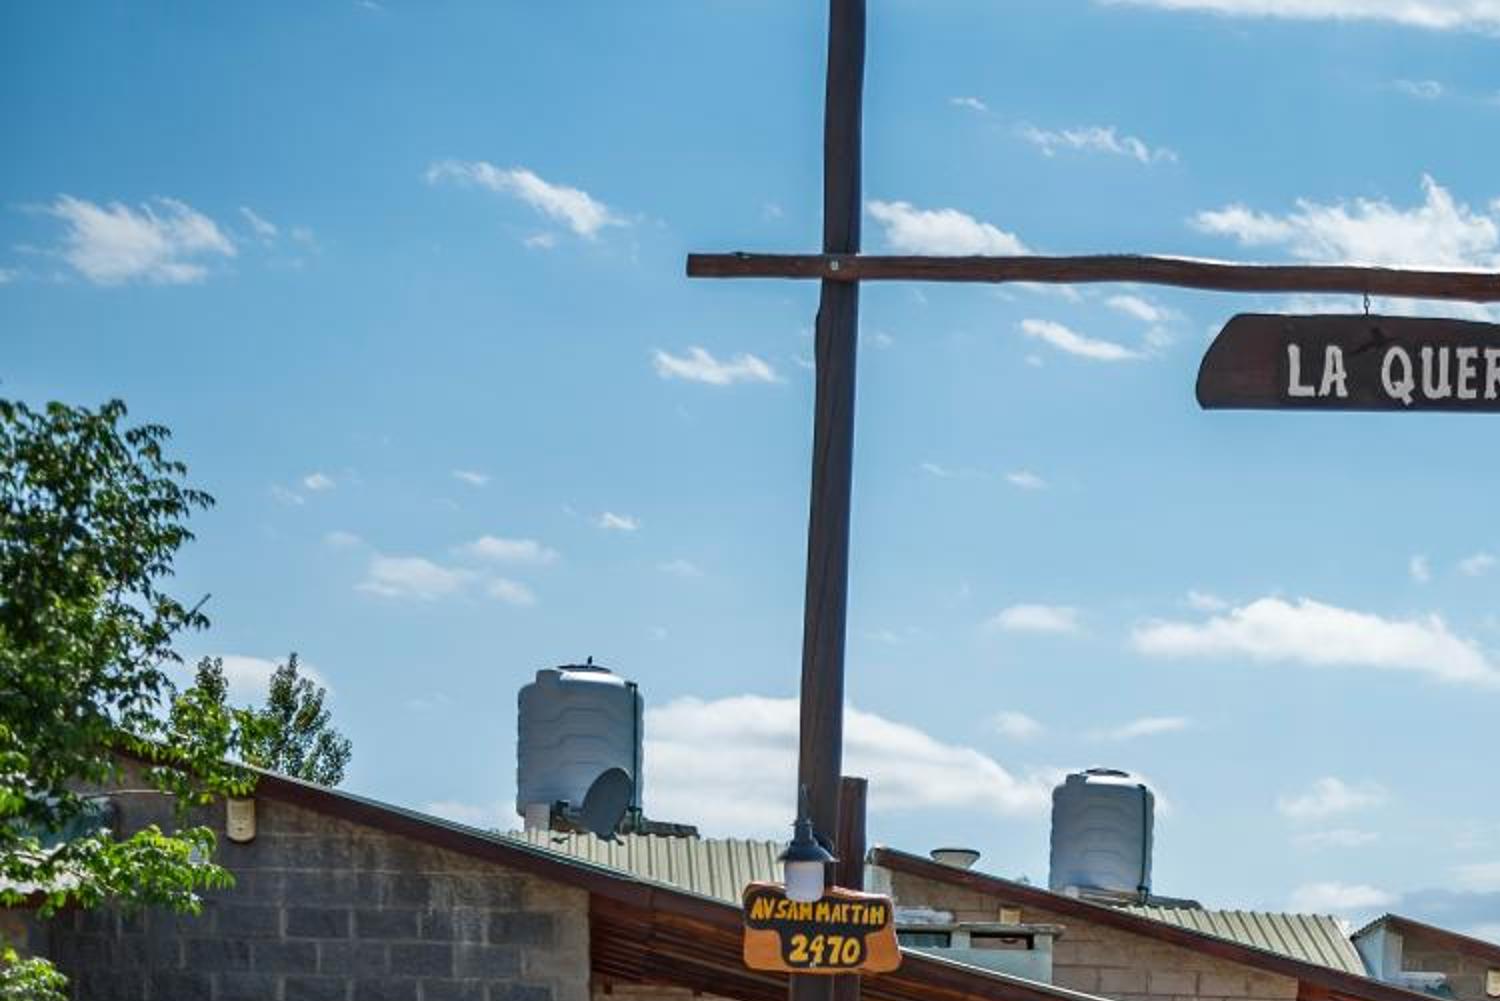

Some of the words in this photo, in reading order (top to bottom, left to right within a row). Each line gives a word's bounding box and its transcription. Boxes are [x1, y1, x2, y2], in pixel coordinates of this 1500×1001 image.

[1287, 344, 1348, 398] LA
[751, 897, 775, 919] AV
[775, 900, 813, 921] SAN
[789, 933, 861, 965] 2470
